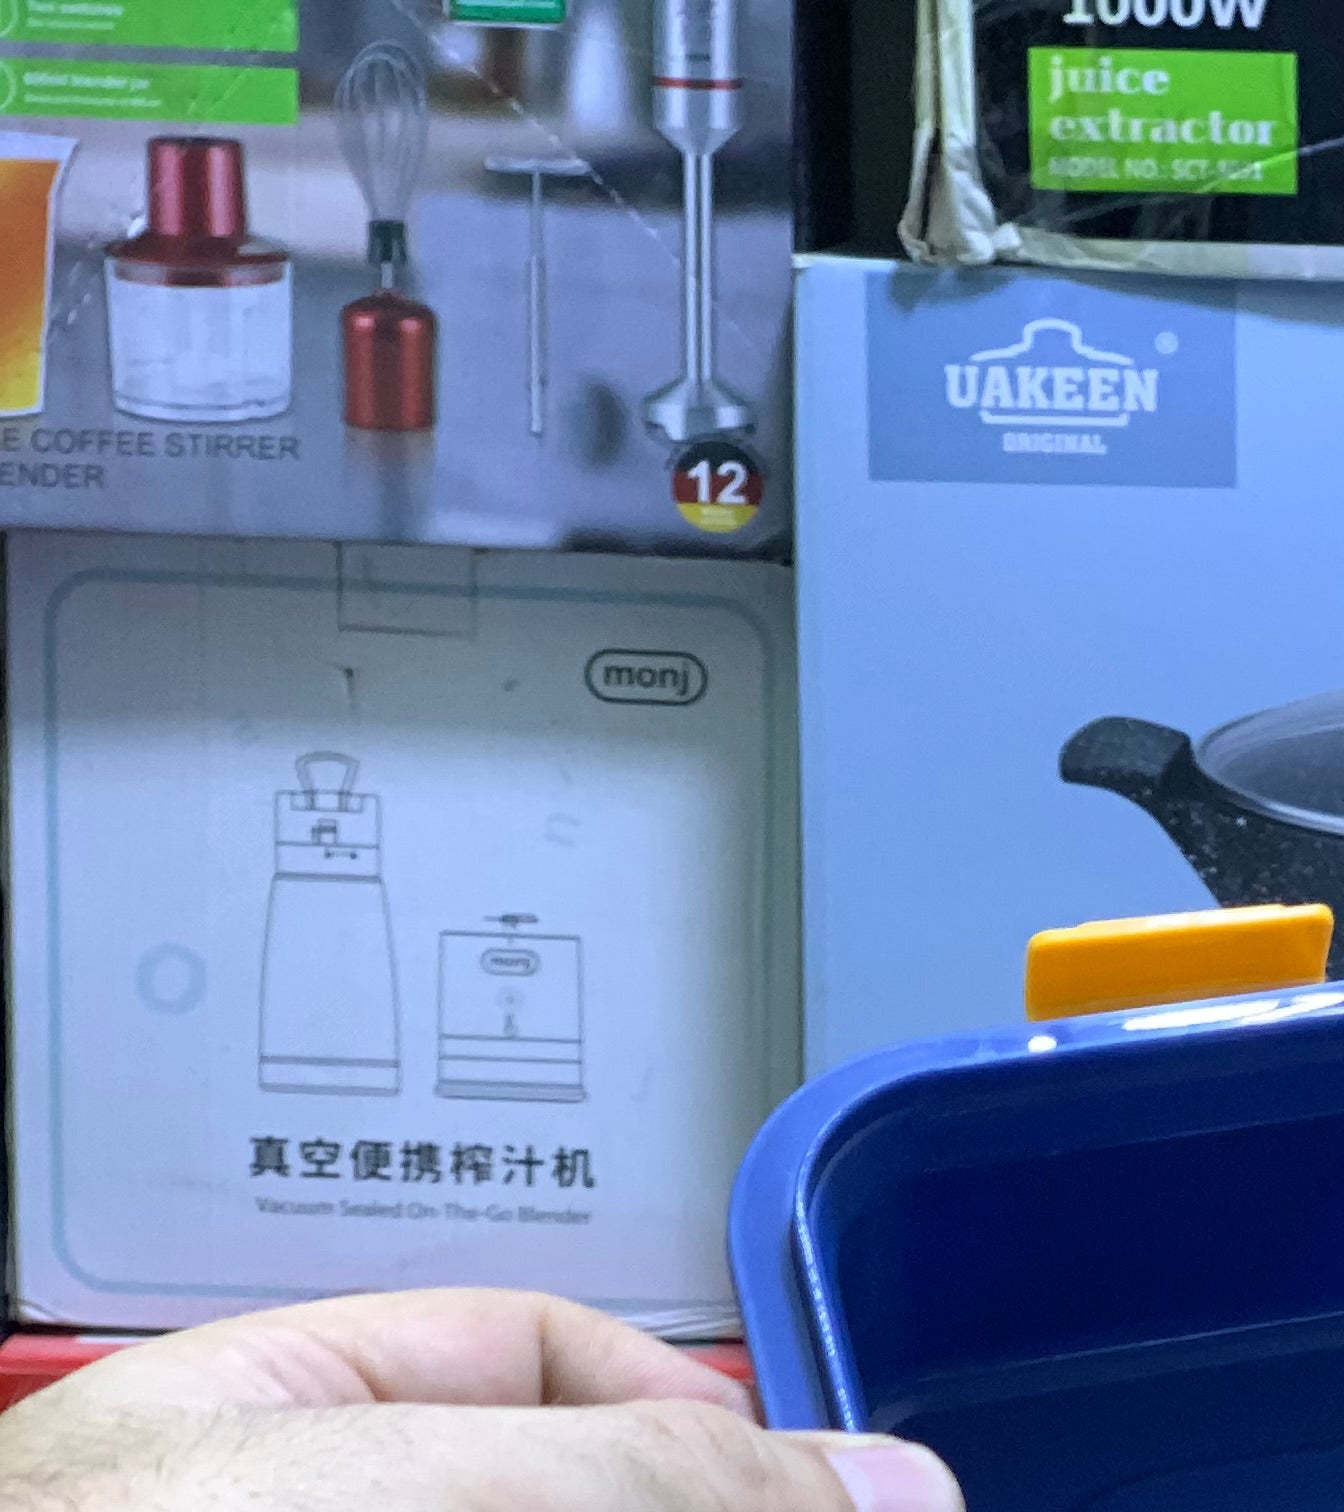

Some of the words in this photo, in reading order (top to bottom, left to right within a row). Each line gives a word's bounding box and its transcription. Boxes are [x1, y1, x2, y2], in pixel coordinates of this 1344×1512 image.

[1049, 55, 1170, 103] juice
[1050, 108, 1277, 147] extractor
[944, 364, 1159, 413] UAKEEN
[30, 428, 154, 457] COFFEE
[164, 432, 300, 461] STIRRER
[688, 460, 748, 504] 12
[603, 662, 691, 698] monj
[249, 1136, 596, 1188] 真空便携榨汁机
